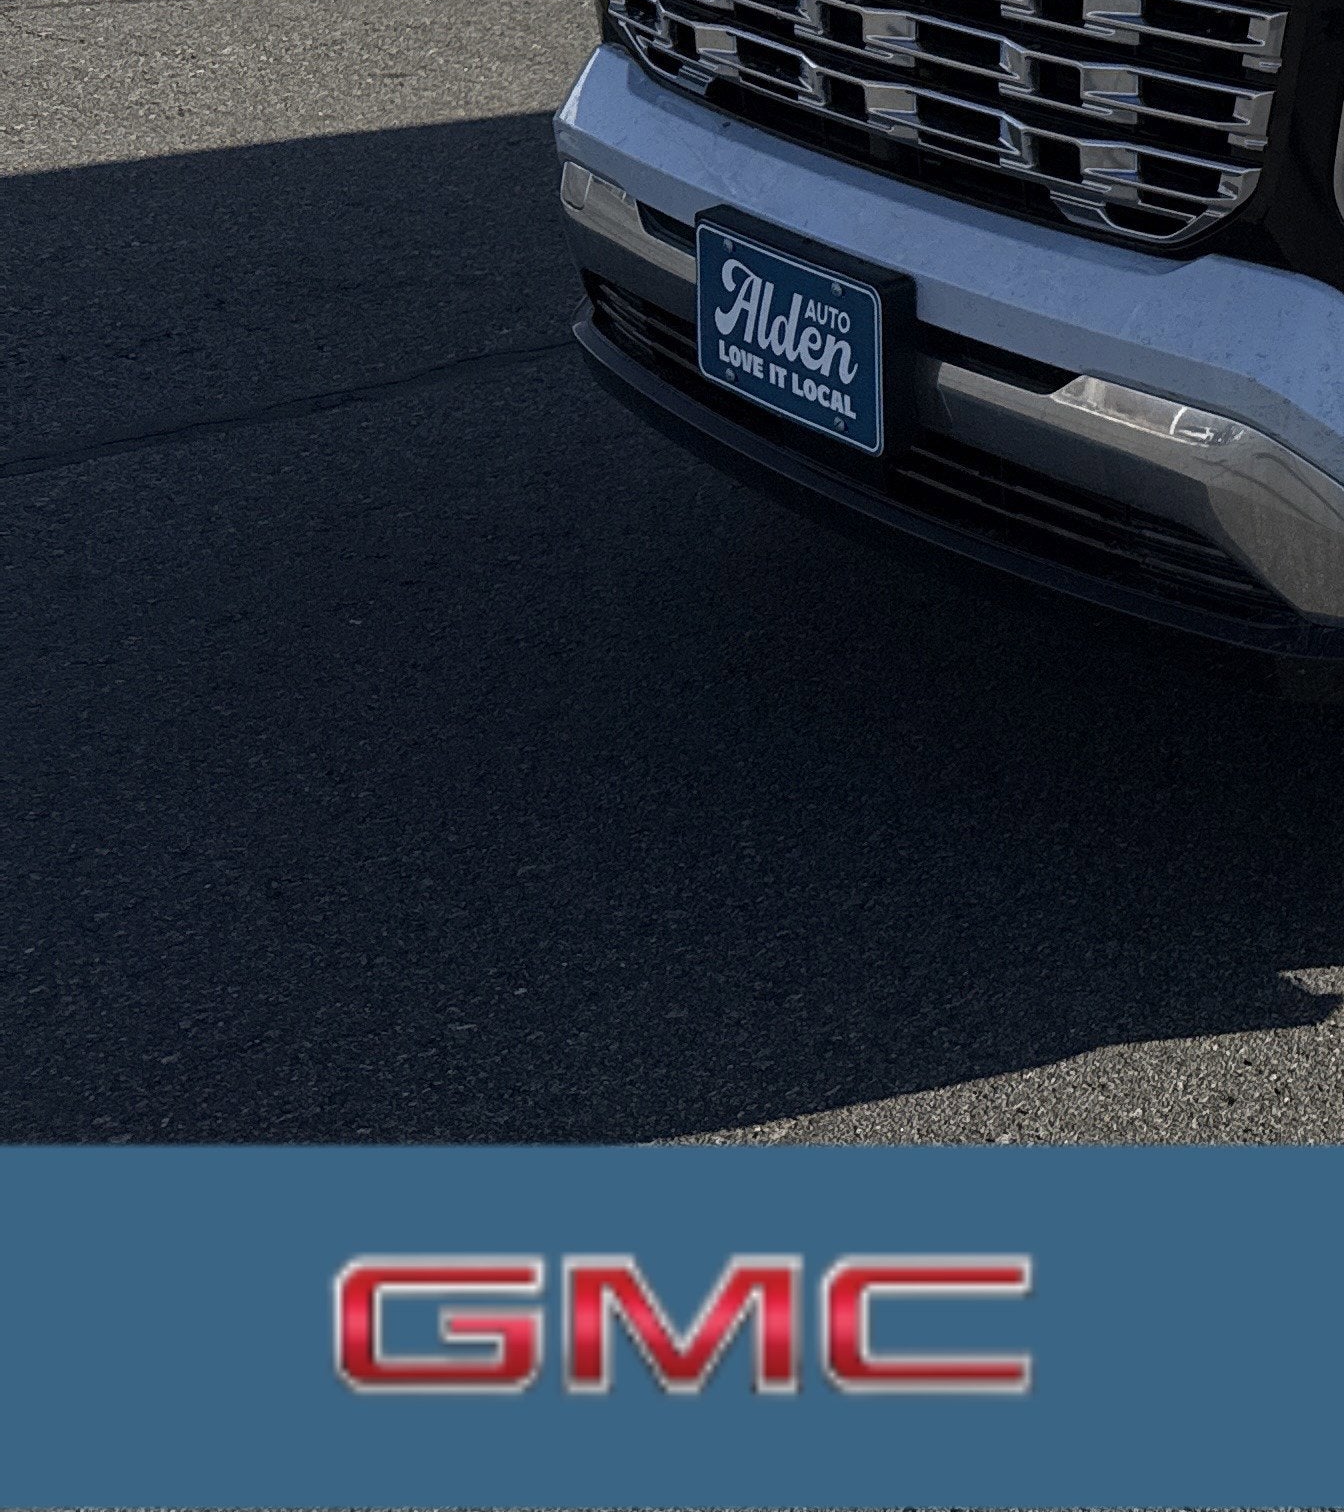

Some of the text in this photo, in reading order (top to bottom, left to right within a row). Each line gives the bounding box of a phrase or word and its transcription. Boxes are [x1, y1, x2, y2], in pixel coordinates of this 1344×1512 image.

[714, 258, 859, 385] Alden
[804, 298, 851, 334] AUTO
[718, 339, 857, 420] LOVE IT LOCAL
